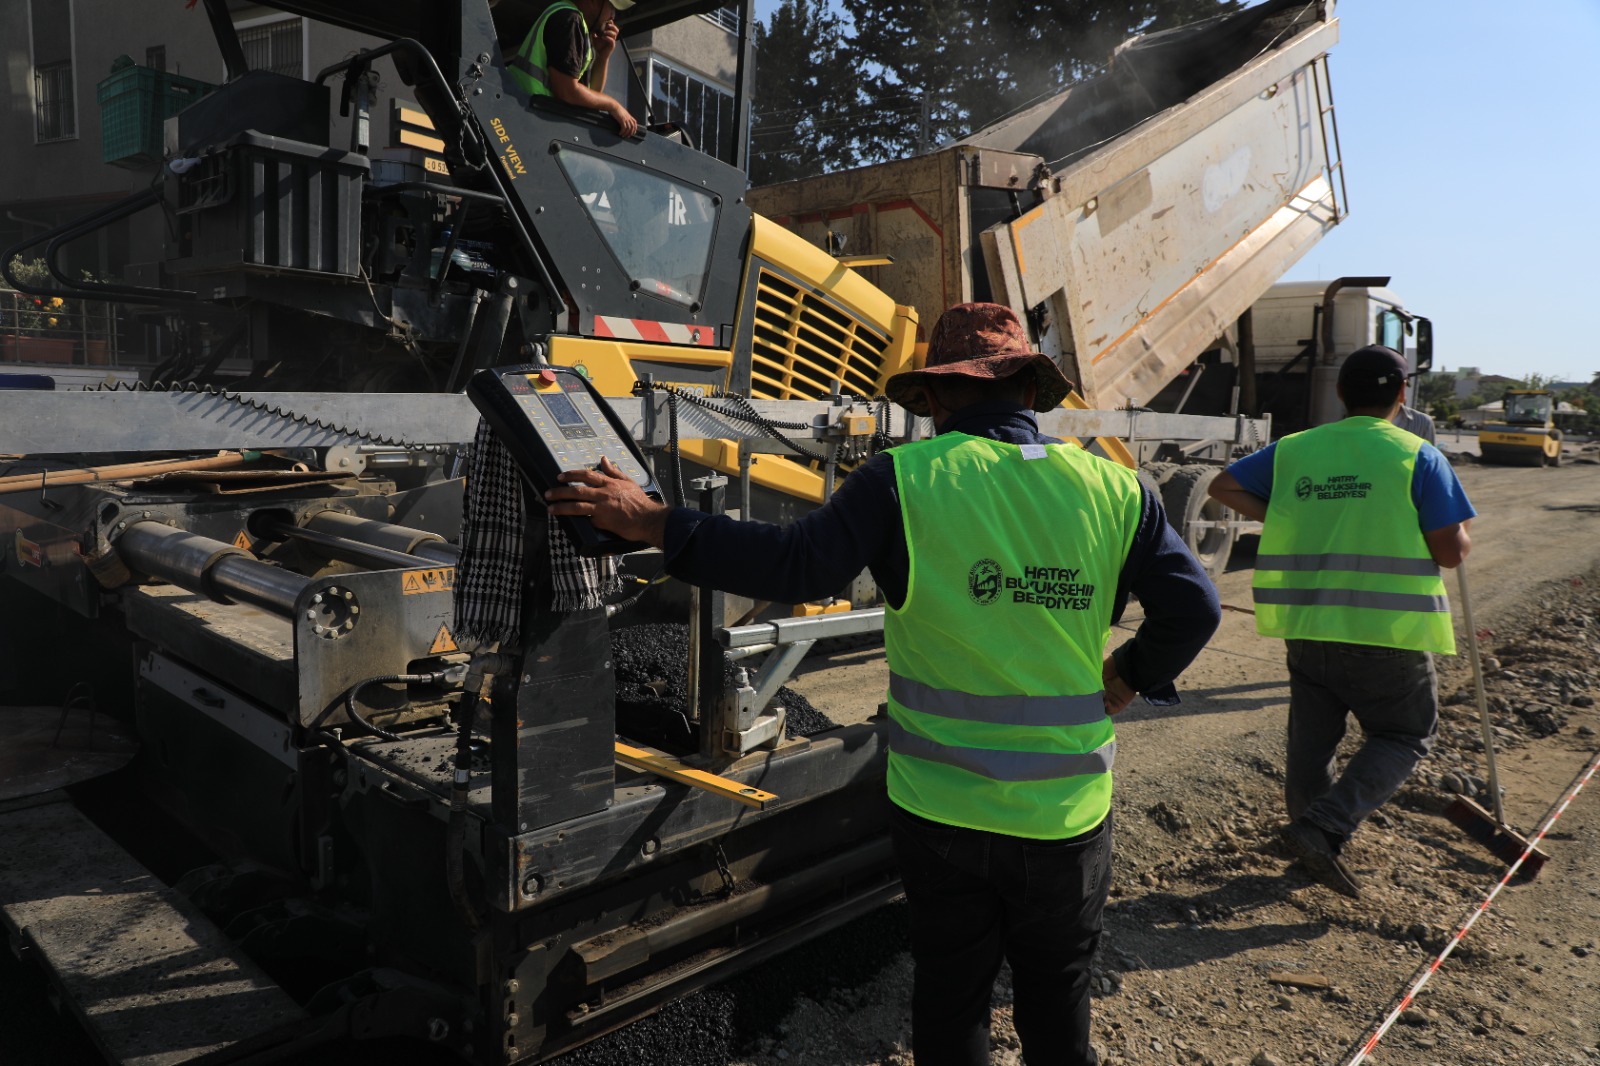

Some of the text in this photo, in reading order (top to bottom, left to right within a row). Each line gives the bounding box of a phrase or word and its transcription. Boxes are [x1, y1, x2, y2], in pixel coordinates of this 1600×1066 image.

[490, 117, 527, 174] SIDE VIEW
[1024, 565, 1080, 582] HATAY
